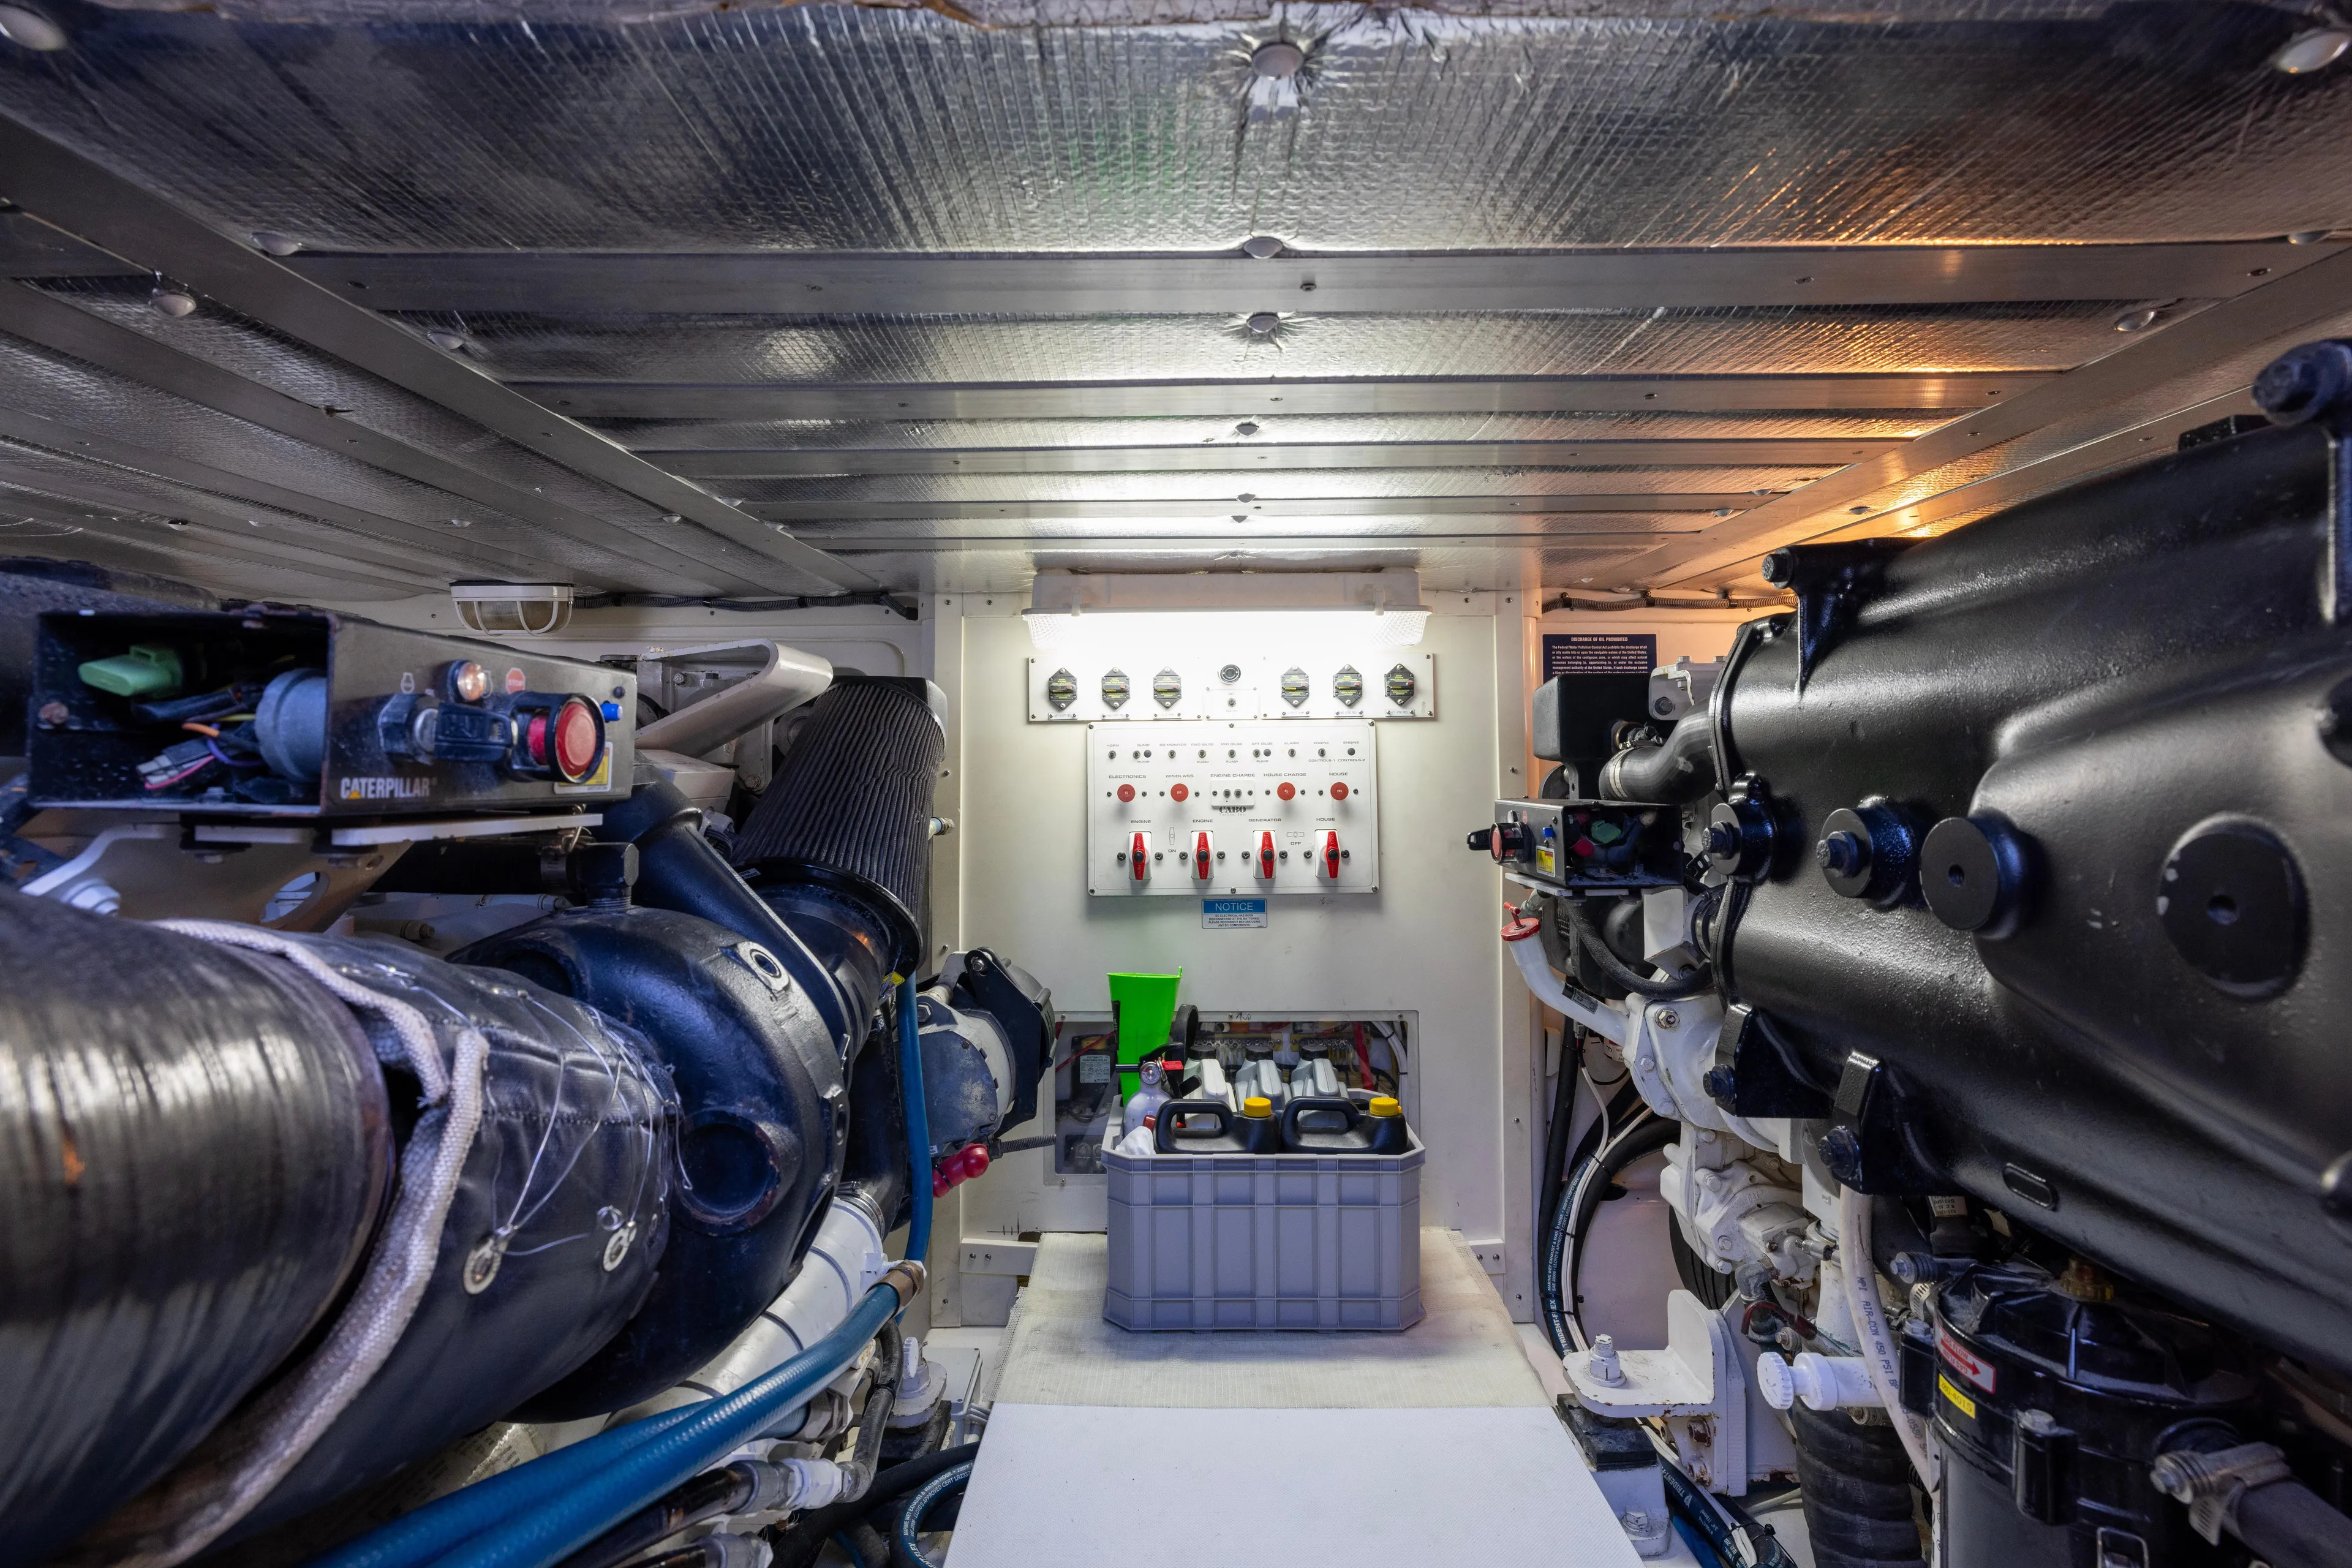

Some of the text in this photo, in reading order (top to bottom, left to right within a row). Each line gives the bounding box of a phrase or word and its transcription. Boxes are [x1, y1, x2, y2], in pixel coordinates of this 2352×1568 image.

[341, 777, 430, 799] CATERPILLAR
[1215, 903, 1253, 911] NOTICE
[1550, 1300, 1568, 1348] TRIDENT-FEX
[1857, 1277, 1893, 1374] MPI AIR-CON 450 PSI
[909, 1494, 922, 1512] EXHAUST
[924, 1479, 939, 1492] WATER
[938, 1472, 953, 1481] HOSE
[956, 1464, 970, 1472] 250°F
[914, 1503, 924, 1518] LLOYD'S
[924, 1484, 942, 1504] APPROVED
[942, 1477, 954, 1488] CERT
